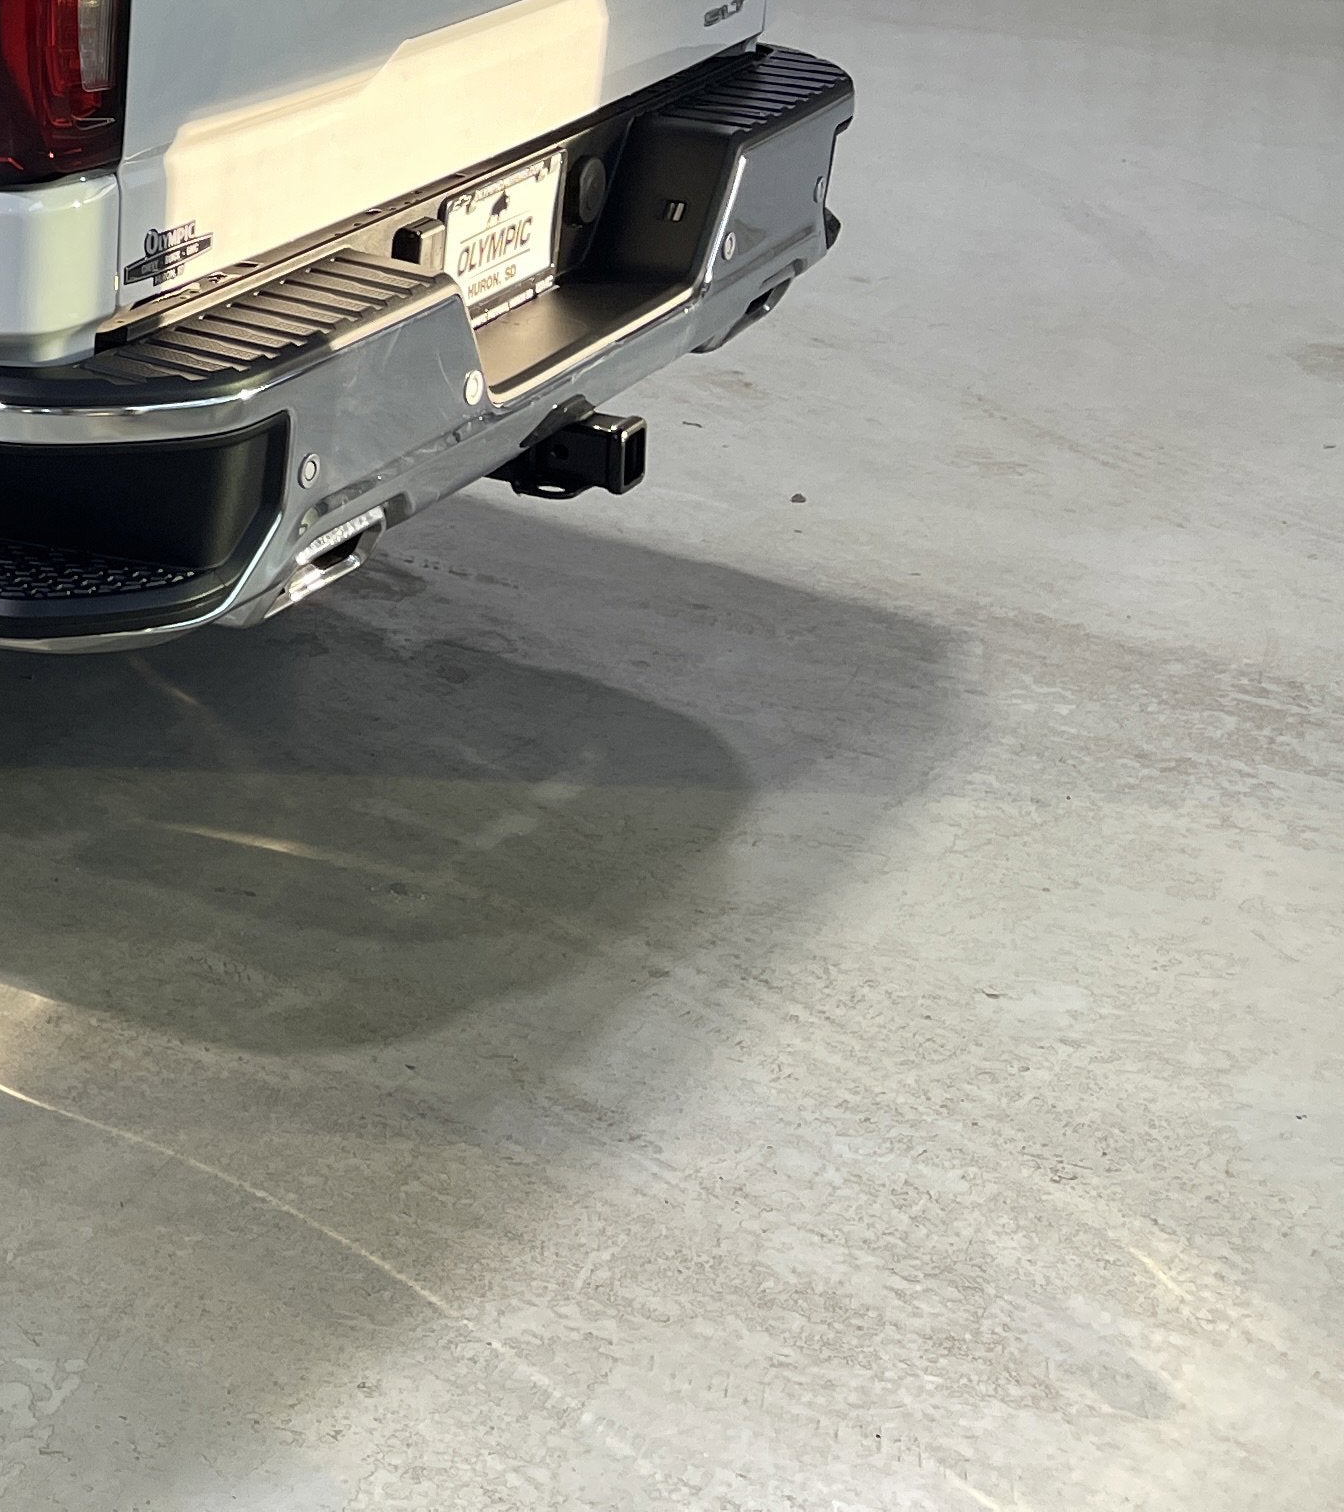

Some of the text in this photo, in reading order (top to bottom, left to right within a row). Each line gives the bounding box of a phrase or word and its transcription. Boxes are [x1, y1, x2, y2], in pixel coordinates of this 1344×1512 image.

[457, 215, 533, 277] OLYMPIC
[467, 264, 517, 300] HURON, SD
